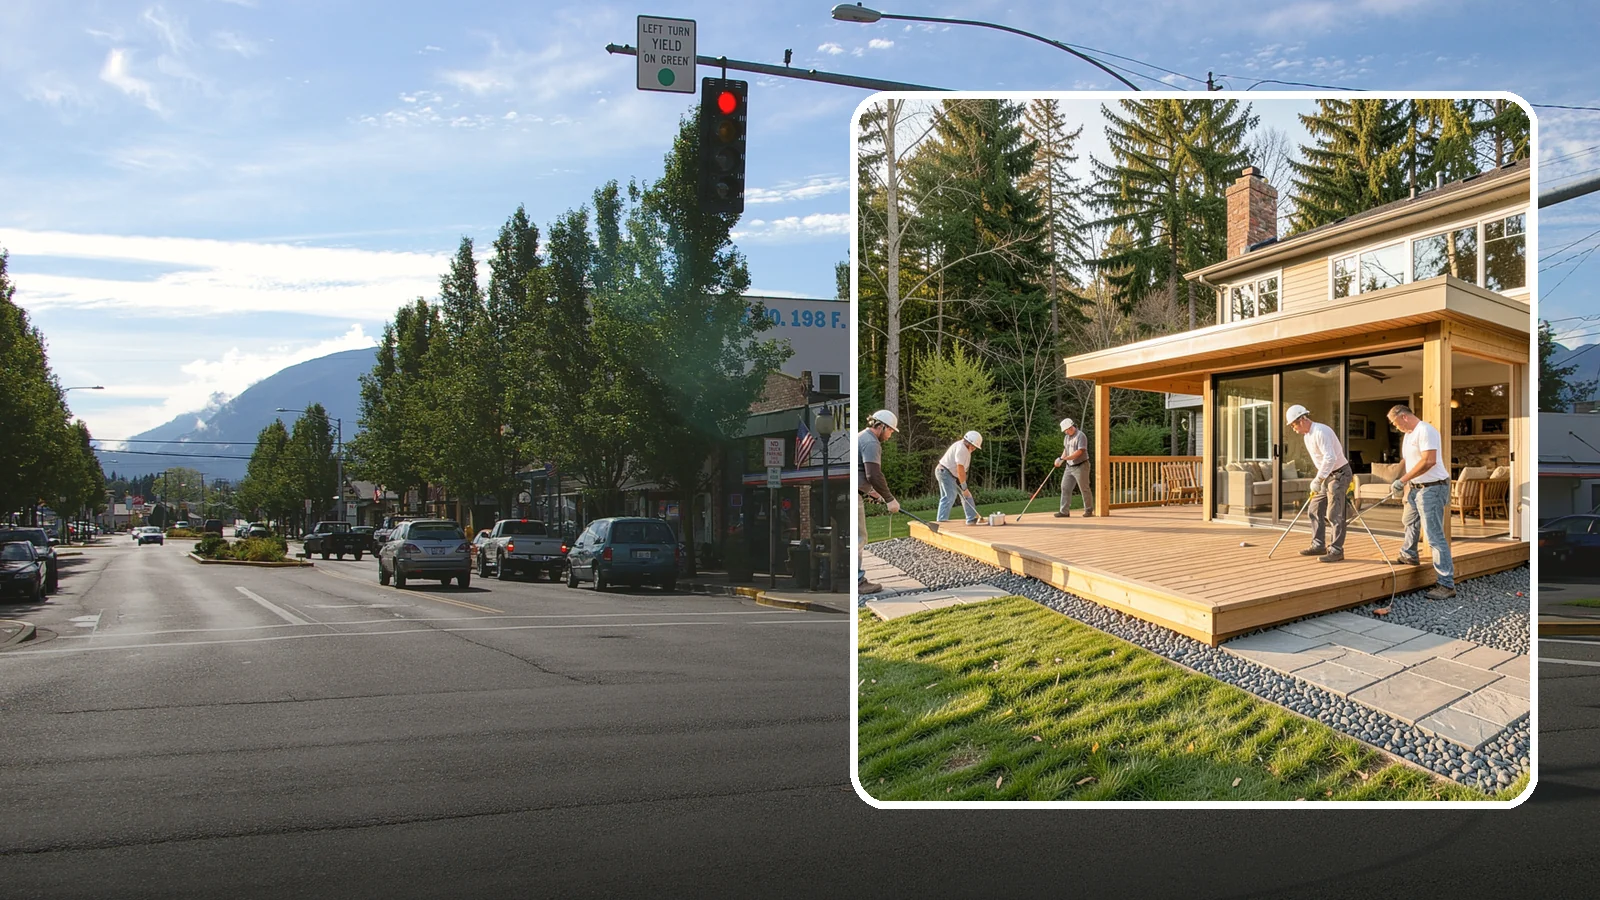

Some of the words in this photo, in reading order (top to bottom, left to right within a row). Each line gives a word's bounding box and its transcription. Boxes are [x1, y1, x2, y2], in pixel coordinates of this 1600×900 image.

[643, 23, 663, 34] LEFT
[668, 25, 690, 37] TURN
[652, 37, 682, 52] YIELD
[643, 53, 656, 64] ON
[661, 54, 688, 66] GREEN
[791, 309, 826, 328] 198
[831, 311, 847, 329] F.
